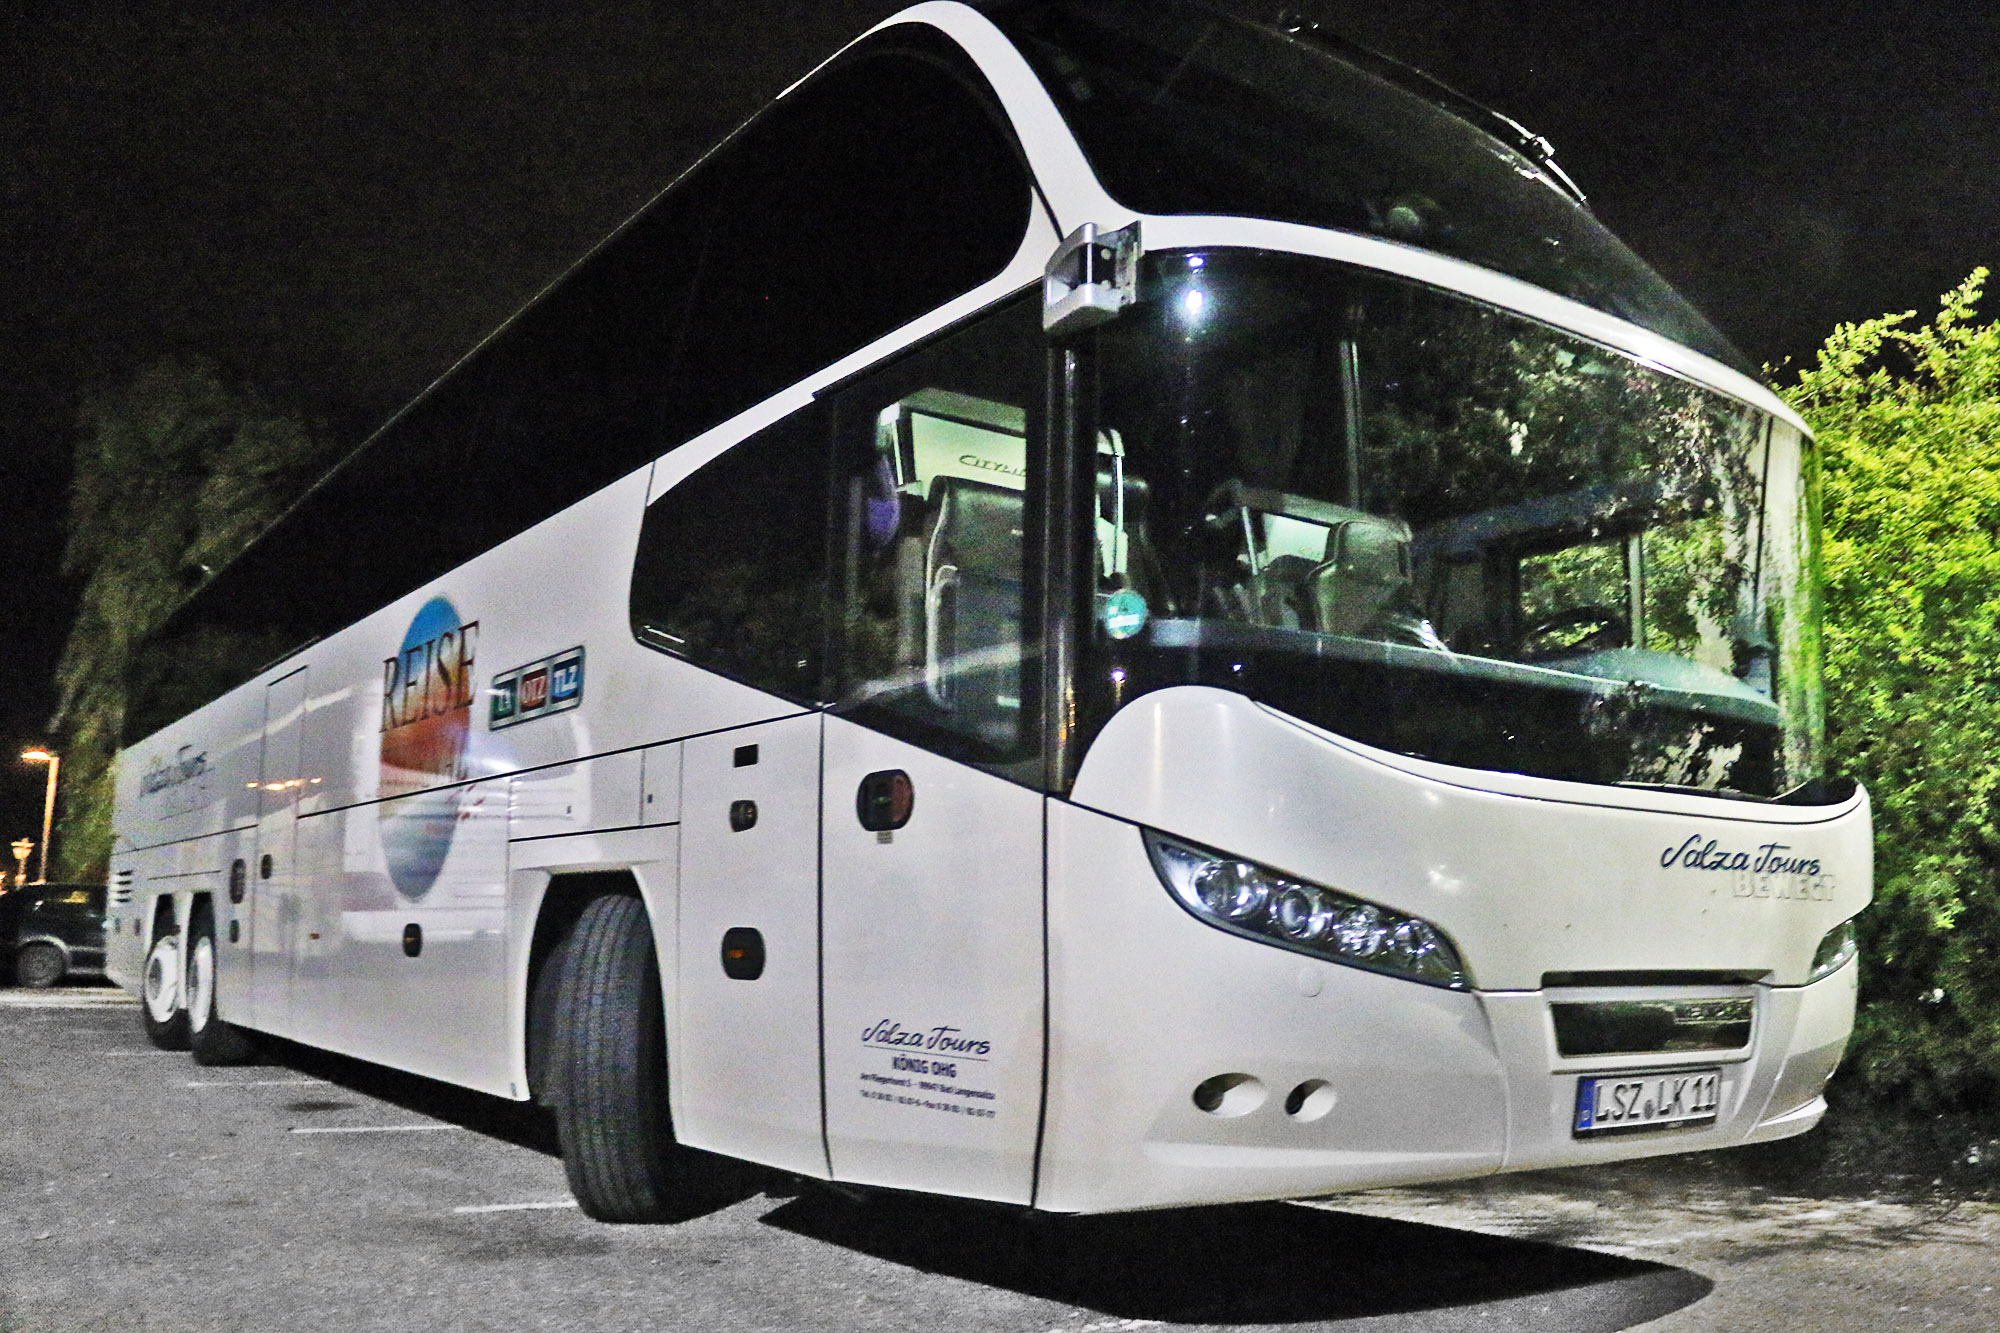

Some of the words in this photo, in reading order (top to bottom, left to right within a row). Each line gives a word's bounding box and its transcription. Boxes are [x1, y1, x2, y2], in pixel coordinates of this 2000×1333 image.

[380, 620, 479, 733] REISE
[553, 664, 578, 695] TLZ
[1660, 834, 1750, 871] Salza
[1753, 842, 1821, 876] Tours
[861, 1018, 925, 1047] Salza
[926, 1025, 991, 1055] Tours
[931, 1061, 957, 1079] OHG
